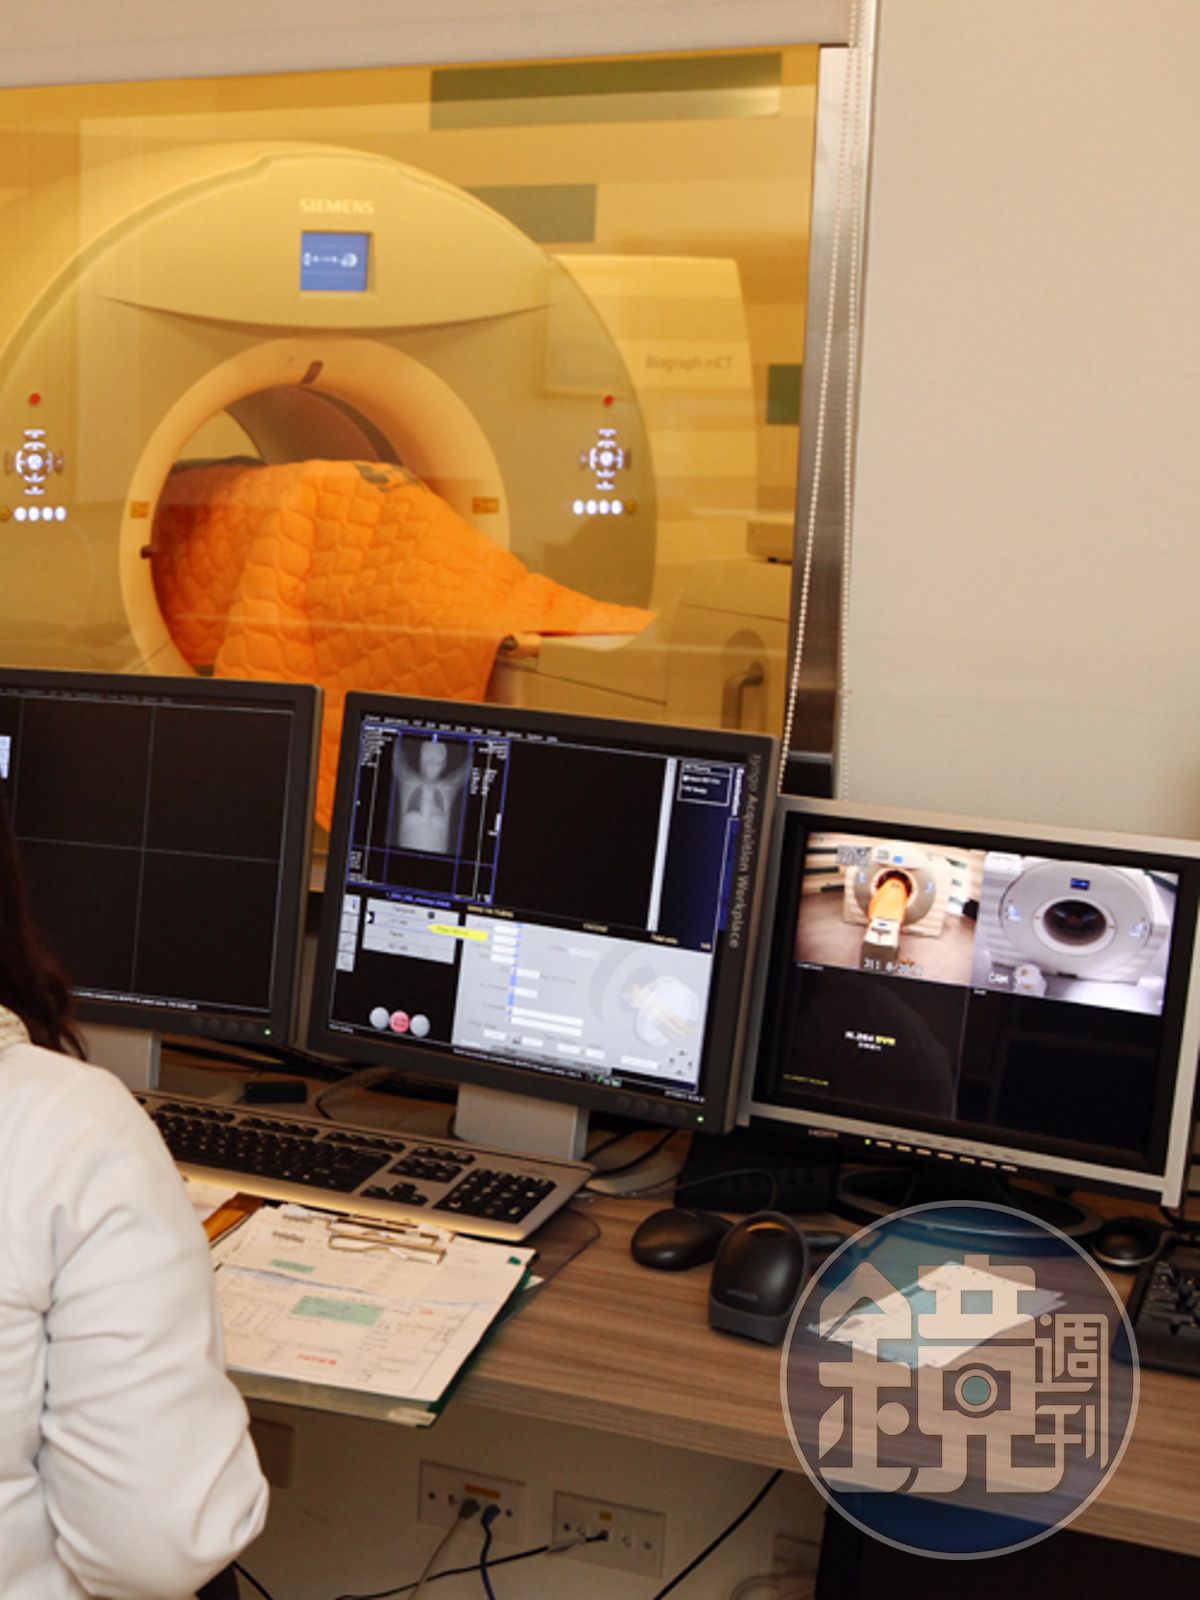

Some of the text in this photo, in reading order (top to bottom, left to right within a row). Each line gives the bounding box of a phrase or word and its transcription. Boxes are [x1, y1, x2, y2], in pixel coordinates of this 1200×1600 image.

[299, 198, 375, 215] SIEMENS
[736, 793, 760, 873] Acquisition
[728, 875, 751, 949] Workplace
